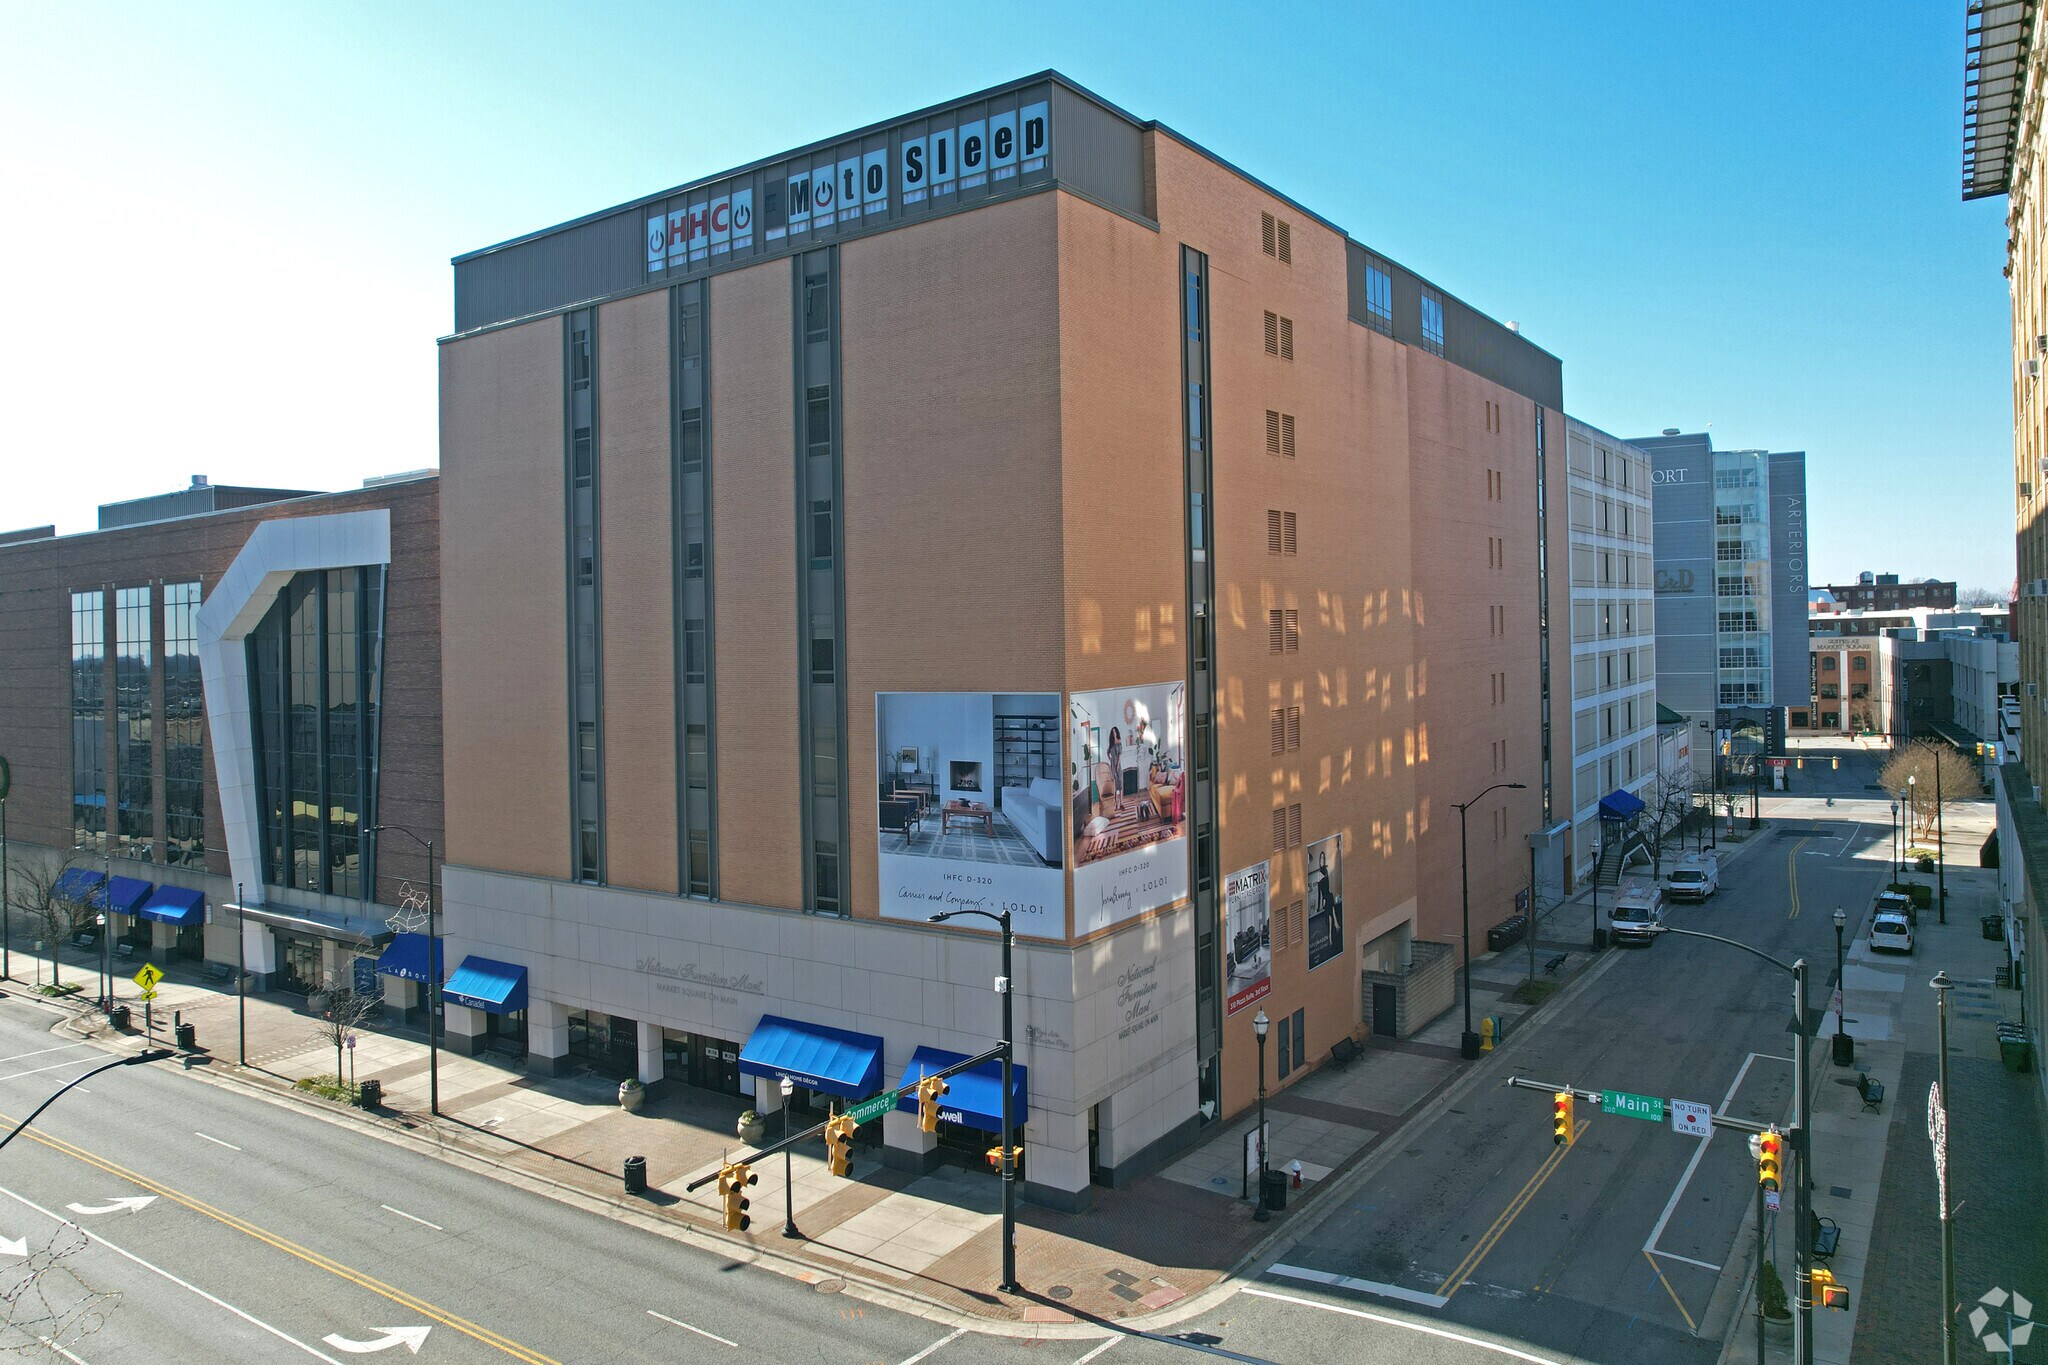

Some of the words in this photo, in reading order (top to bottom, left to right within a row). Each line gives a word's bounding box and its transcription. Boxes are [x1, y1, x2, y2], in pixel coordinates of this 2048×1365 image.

[906, 117, 1044, 183] Sleep
[1788, 497, 1804, 593] ARTERIORS
[943, 873, 963, 882] IHFC
[967, 876, 993, 885] D-320
[1143, 876, 1168, 892] LOLOI
[1236, 870, 1266, 894] MATRIX
[928, 891, 944, 901] and
[1002, 902, 1044, 915] LOLOI
[636, 957, 682, 977] National
[1118, 956, 1157, 987] National
[464, 997, 485, 1009] Canadel
[657, 983, 681, 995] MARKET
[682, 988, 707, 1000] SQUARE
[709, 993, 719, 1001] ON
[721, 995, 739, 1006] MAIN
[1118, 982, 1158, 1007] Furniture
[846, 1098, 889, 1119] Commerce
[1604, 1105, 1615, 1114] 200
[1650, 1113, 1662, 1121] 100
[1615, 1094, 1649, 1112] Main
[1653, 1100, 1662, 1108] St
[1674, 1103, 1685, 1111] NO
[1688, 1105, 1707, 1114] TURN
[1678, 1123, 1689, 1132] ON
[1691, 1125, 1707, 1134] RED
